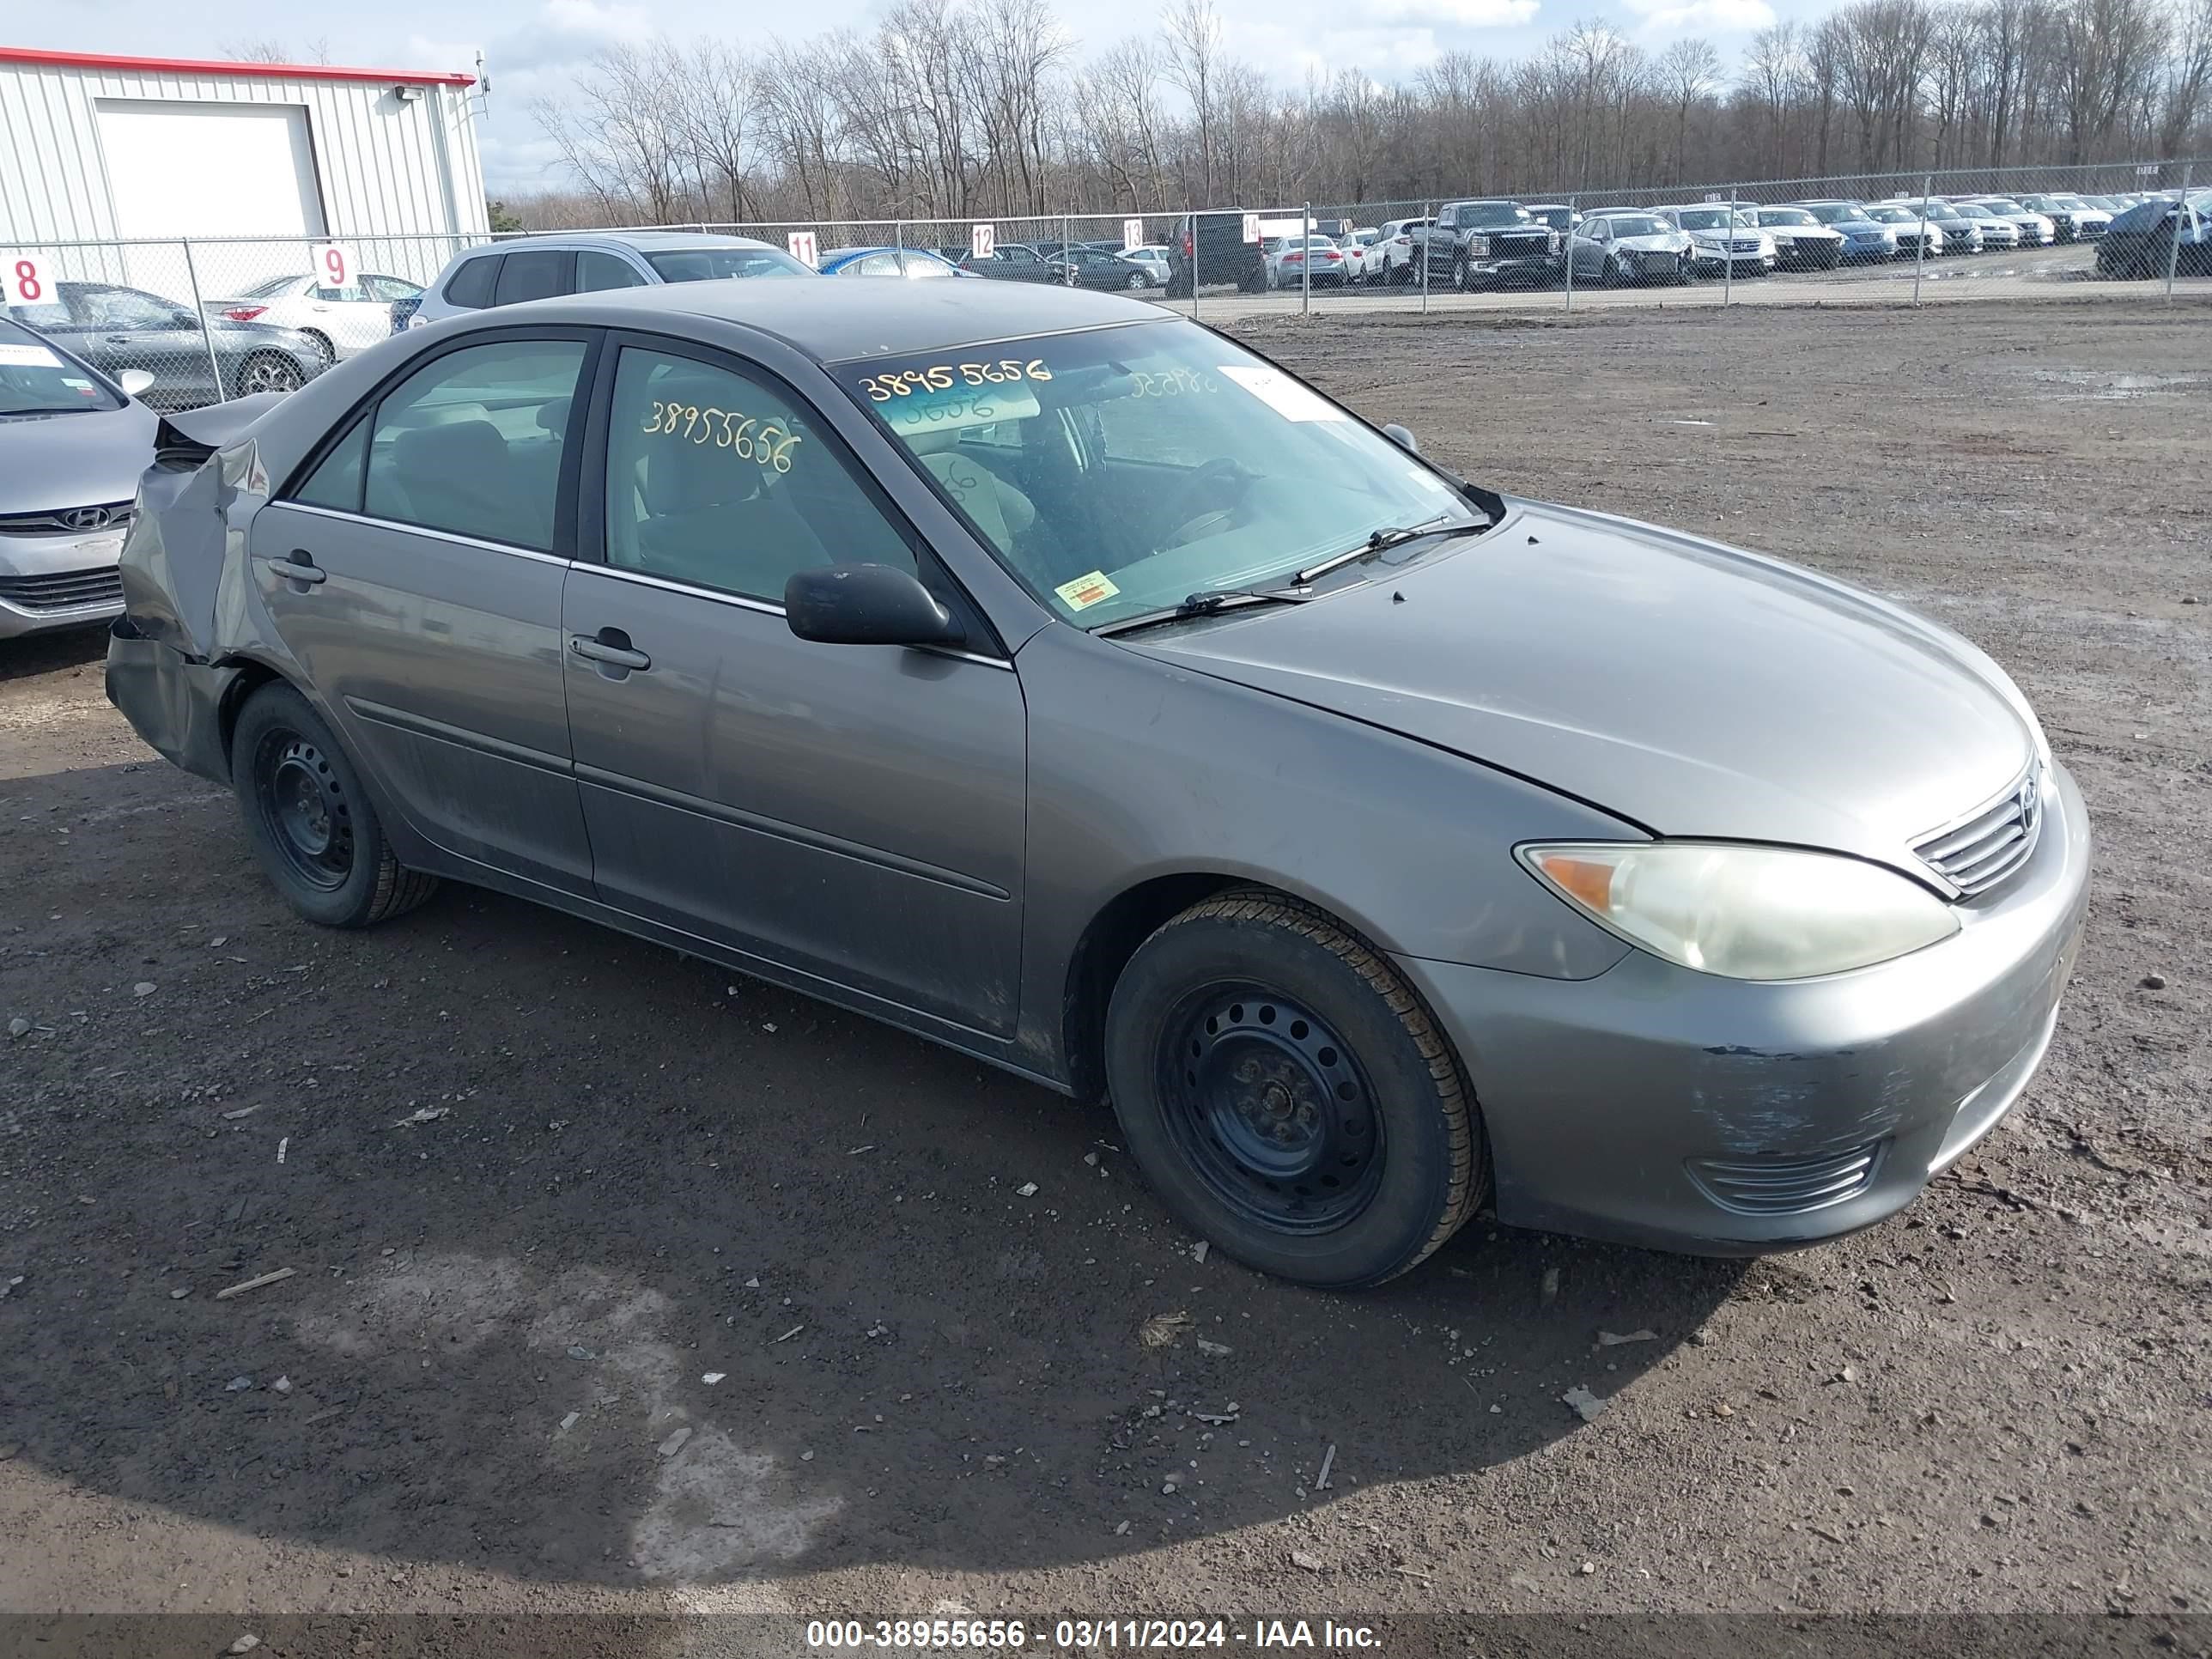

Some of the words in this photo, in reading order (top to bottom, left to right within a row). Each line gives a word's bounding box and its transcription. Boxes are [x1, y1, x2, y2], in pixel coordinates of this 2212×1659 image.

[975, 228, 992, 254] 12
[1127, 222, 1141, 246] 13
[1245, 217, 1257, 240] 14
[793, 236, 813, 264] 11
[15, 260, 40, 300] 8
[326, 249, 344, 284] 9
[644, 401, 802, 473] 38955656
